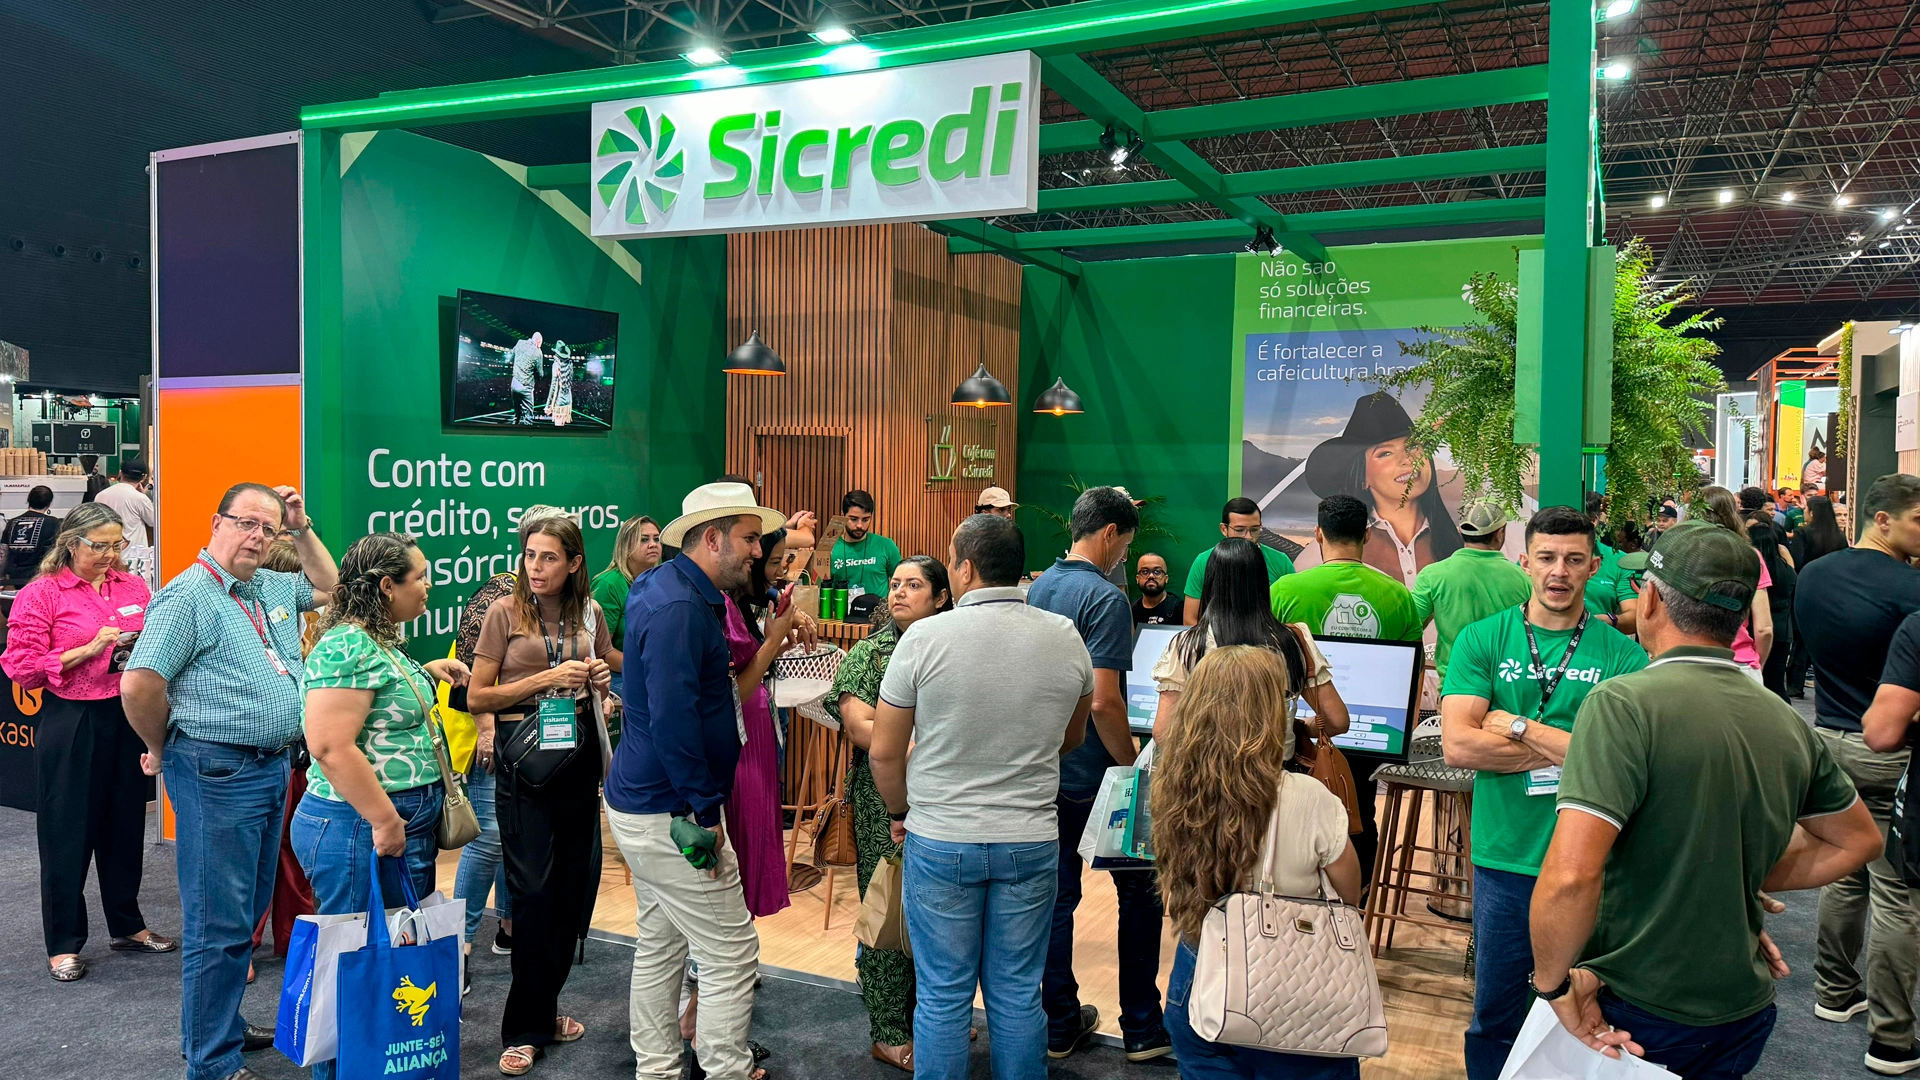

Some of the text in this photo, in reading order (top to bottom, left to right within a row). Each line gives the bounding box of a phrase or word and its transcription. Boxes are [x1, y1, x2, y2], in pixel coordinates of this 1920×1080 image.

[702, 81, 1022, 200] Sicredi
[1260, 260, 1297, 278] Não
[1259, 277, 1371, 300] só soluções
[1258, 300, 1368, 319] financeiras.
[1258, 340, 1383, 361] É fortalecer a
[1257, 363, 1368, 382] cafeicultura
[962, 444, 995, 461] Café com
[367, 448, 546, 488] Conte com
[969, 464, 994, 478] Sicredi
[367, 497, 498, 540] crédito,
[846, 556, 876, 567] Sicredi
[385, 1035, 441, 1056] JUNTE-SE
[383, 1047, 448, 1076] ALIANÇA
